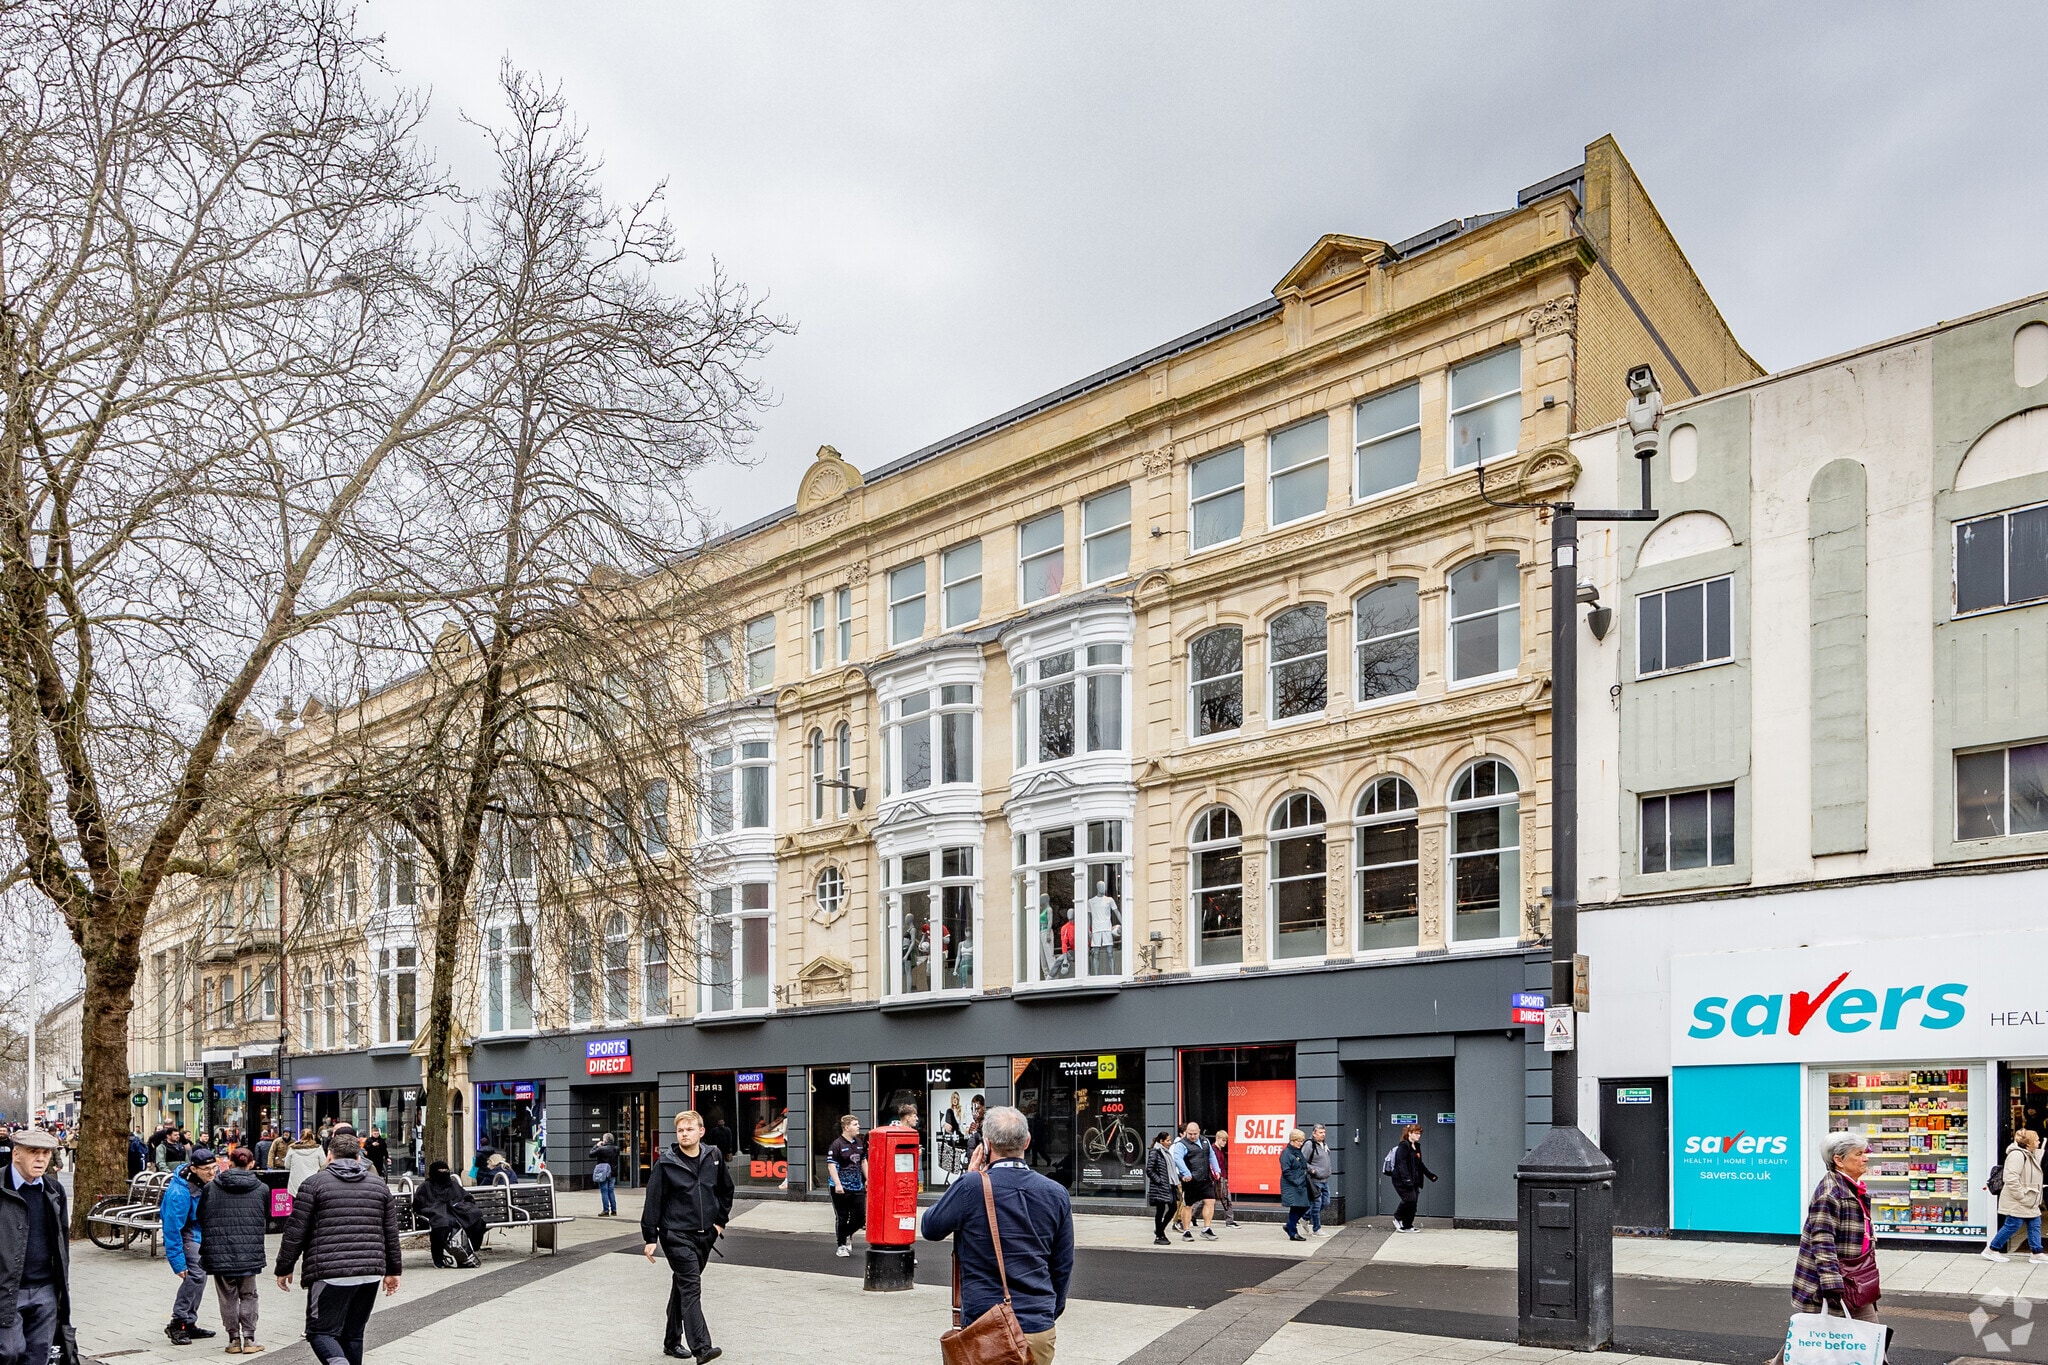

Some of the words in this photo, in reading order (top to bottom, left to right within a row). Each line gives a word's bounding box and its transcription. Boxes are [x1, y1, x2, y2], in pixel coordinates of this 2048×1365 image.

[1520, 995, 1544, 1007] SPORTS
[1687, 970, 1968, 1039] savers
[1520, 1010, 1544, 1022] DIRECT
[1991, 1011, 2048, 1026] HEAL
[588, 1041, 626, 1055] SPORTS
[231, 1058, 244, 1070] LUSH
[589, 1058, 626, 1072] DIRECT
[738, 1074, 760, 1082] SPORTS
[927, 1069, 951, 1082] USC
[738, 1083, 760, 1091] DIRECT
[403, 1091, 416, 1101] USC
[1102, 1103, 1124, 1112] £600
[1244, 1119, 1285, 1139] SALE
[1684, 1129, 1788, 1154] savers
[1250, 1145, 1267, 1154] 70%
[1268, 1145, 1283, 1154] OFF
[750, 1160, 788, 1178] BIG
[1700, 1170, 1771, 1180] savers.co.uk
[1936, 1226, 1960, 1234] 60%
[1829, 1331, 1854, 1339] been
[1798, 1339, 1822, 1347] here
[1824, 1340, 1867, 1350] before
